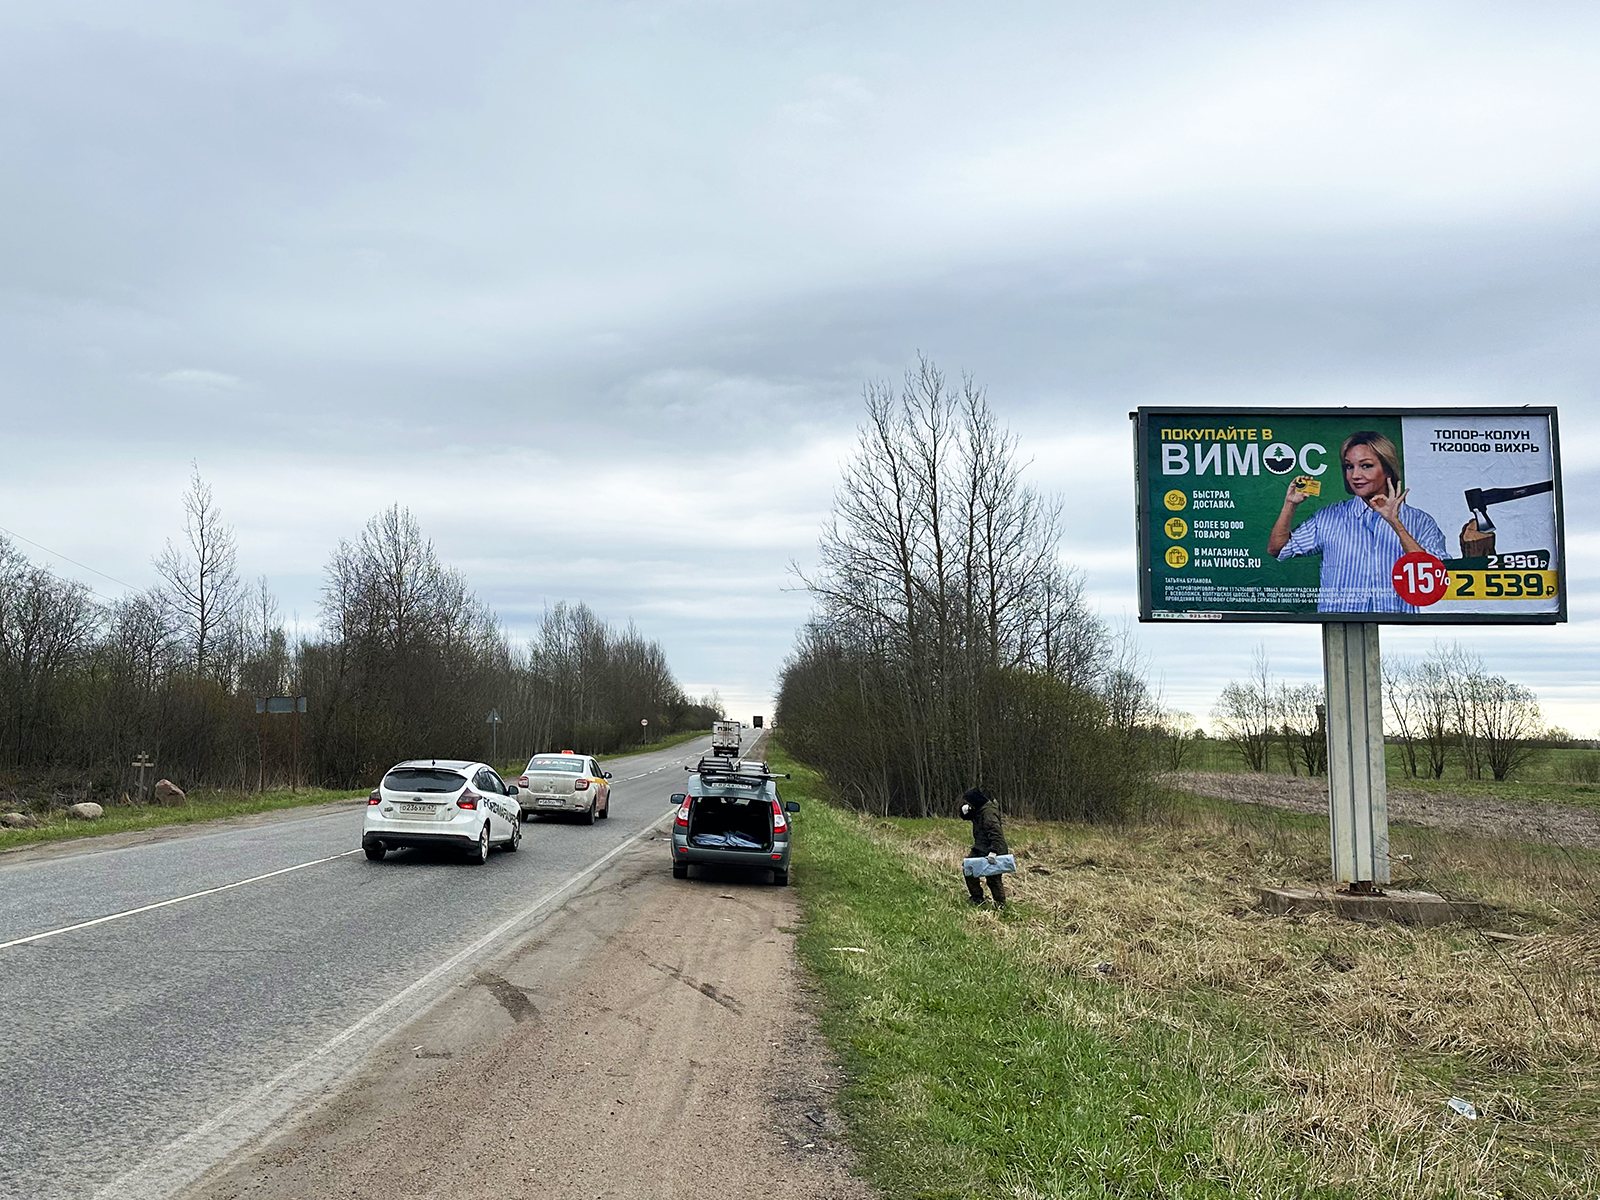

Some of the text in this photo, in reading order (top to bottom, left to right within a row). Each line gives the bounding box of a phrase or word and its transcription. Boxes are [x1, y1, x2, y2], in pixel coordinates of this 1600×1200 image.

[1161, 426, 1273, 440] ПОКУПАЙТЕ В
[1434, 429, 1530, 440] ТОПОР-КОЛУН
[1430, 442, 1540, 453] ТК2000Ф ВИХРЬ
[1161, 442, 1328, 476] ВИМОС
[1192, 490, 1230, 499] БЫСТРАЯ
[1192, 500, 1235, 510] ДОСТАВКА
[1193, 520, 1244, 529] БОЛЕЕ 50 000
[1194, 530, 1231, 539] ТОВАРОВ
[1194, 548, 1249, 557] В МАГАЗИНАХ
[1194, 558, 1261, 568] И НА VIMOS.RU
[1487, 555, 1499, 569] 2
[1393, 562, 1451, 594] -15%
[1455, 573, 1475, 596] 2
